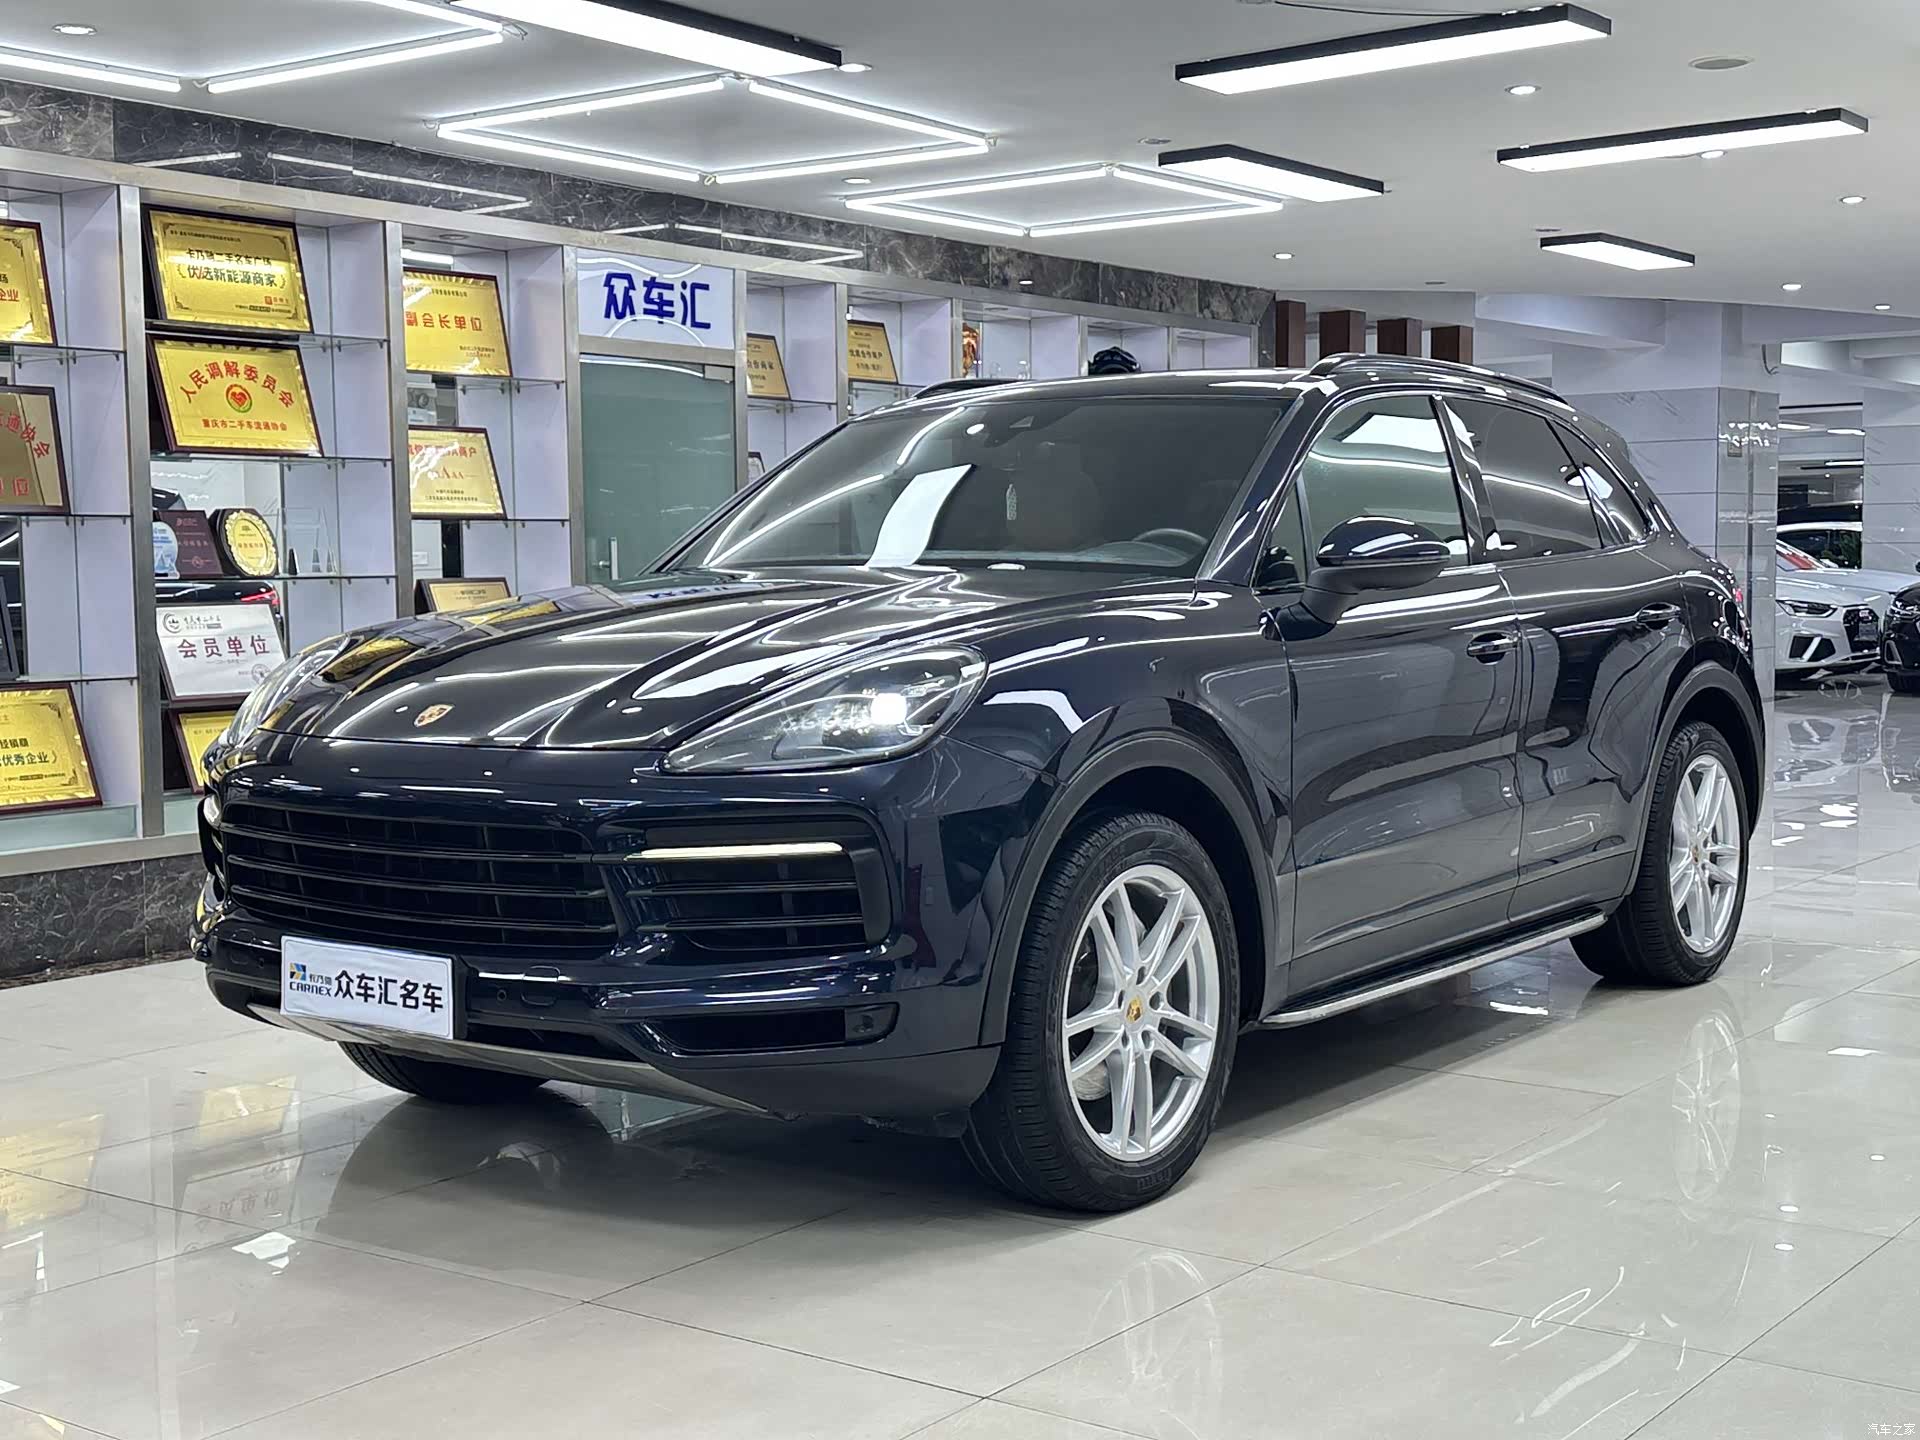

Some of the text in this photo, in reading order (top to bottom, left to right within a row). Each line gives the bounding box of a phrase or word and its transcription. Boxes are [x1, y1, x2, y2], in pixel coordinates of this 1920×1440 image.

[187, 265, 278, 287] 优选新能源商家
[604, 272, 711, 329] 众车汇
[405, 311, 482, 331] 副会长单位
[180, 360, 294, 408] 人民调解委员会
[202, 418, 287, 431] 重庆市二手车流通协会
[177, 635, 270, 658] 会员单位
[289, 982, 332, 997] CARNEX
[334, 970, 443, 1013] 众车汇名车
